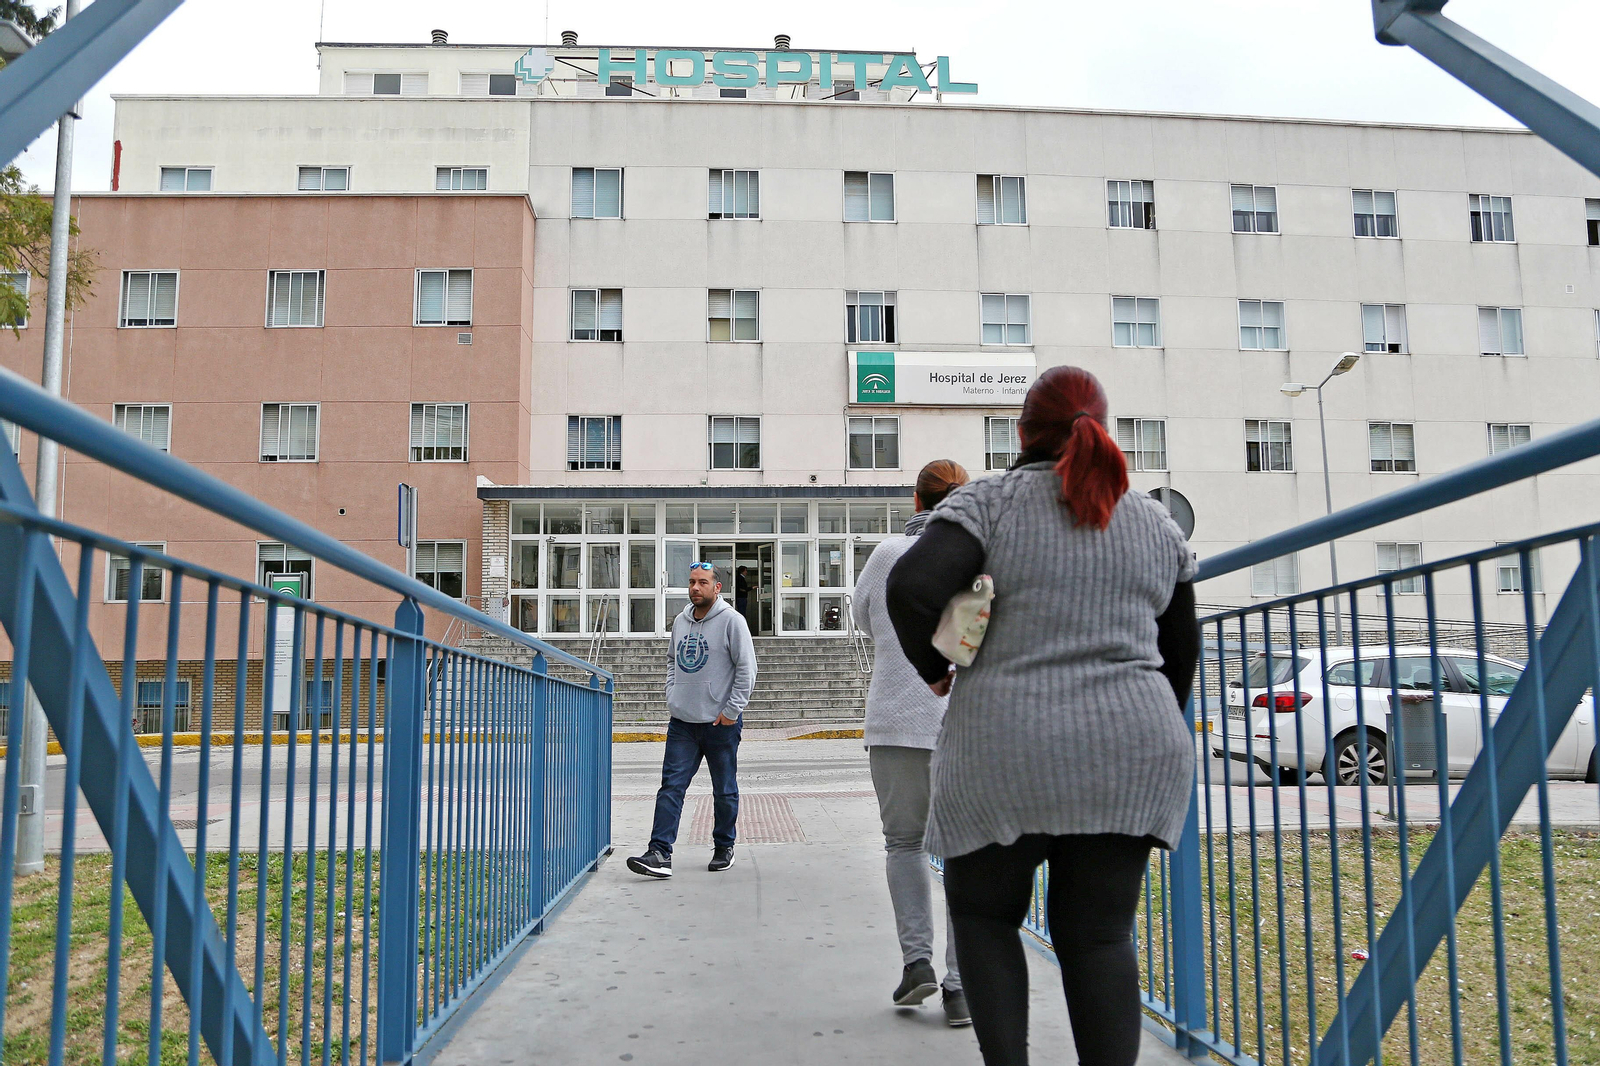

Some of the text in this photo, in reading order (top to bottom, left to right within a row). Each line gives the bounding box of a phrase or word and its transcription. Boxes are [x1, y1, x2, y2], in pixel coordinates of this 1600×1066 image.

[597, 48, 978, 94] HOSPITAL
[929, 372, 1027, 386] Hospital de Jerez
[962, 386, 995, 395] Materno
[1002, 386, 1028, 395] Infantil
